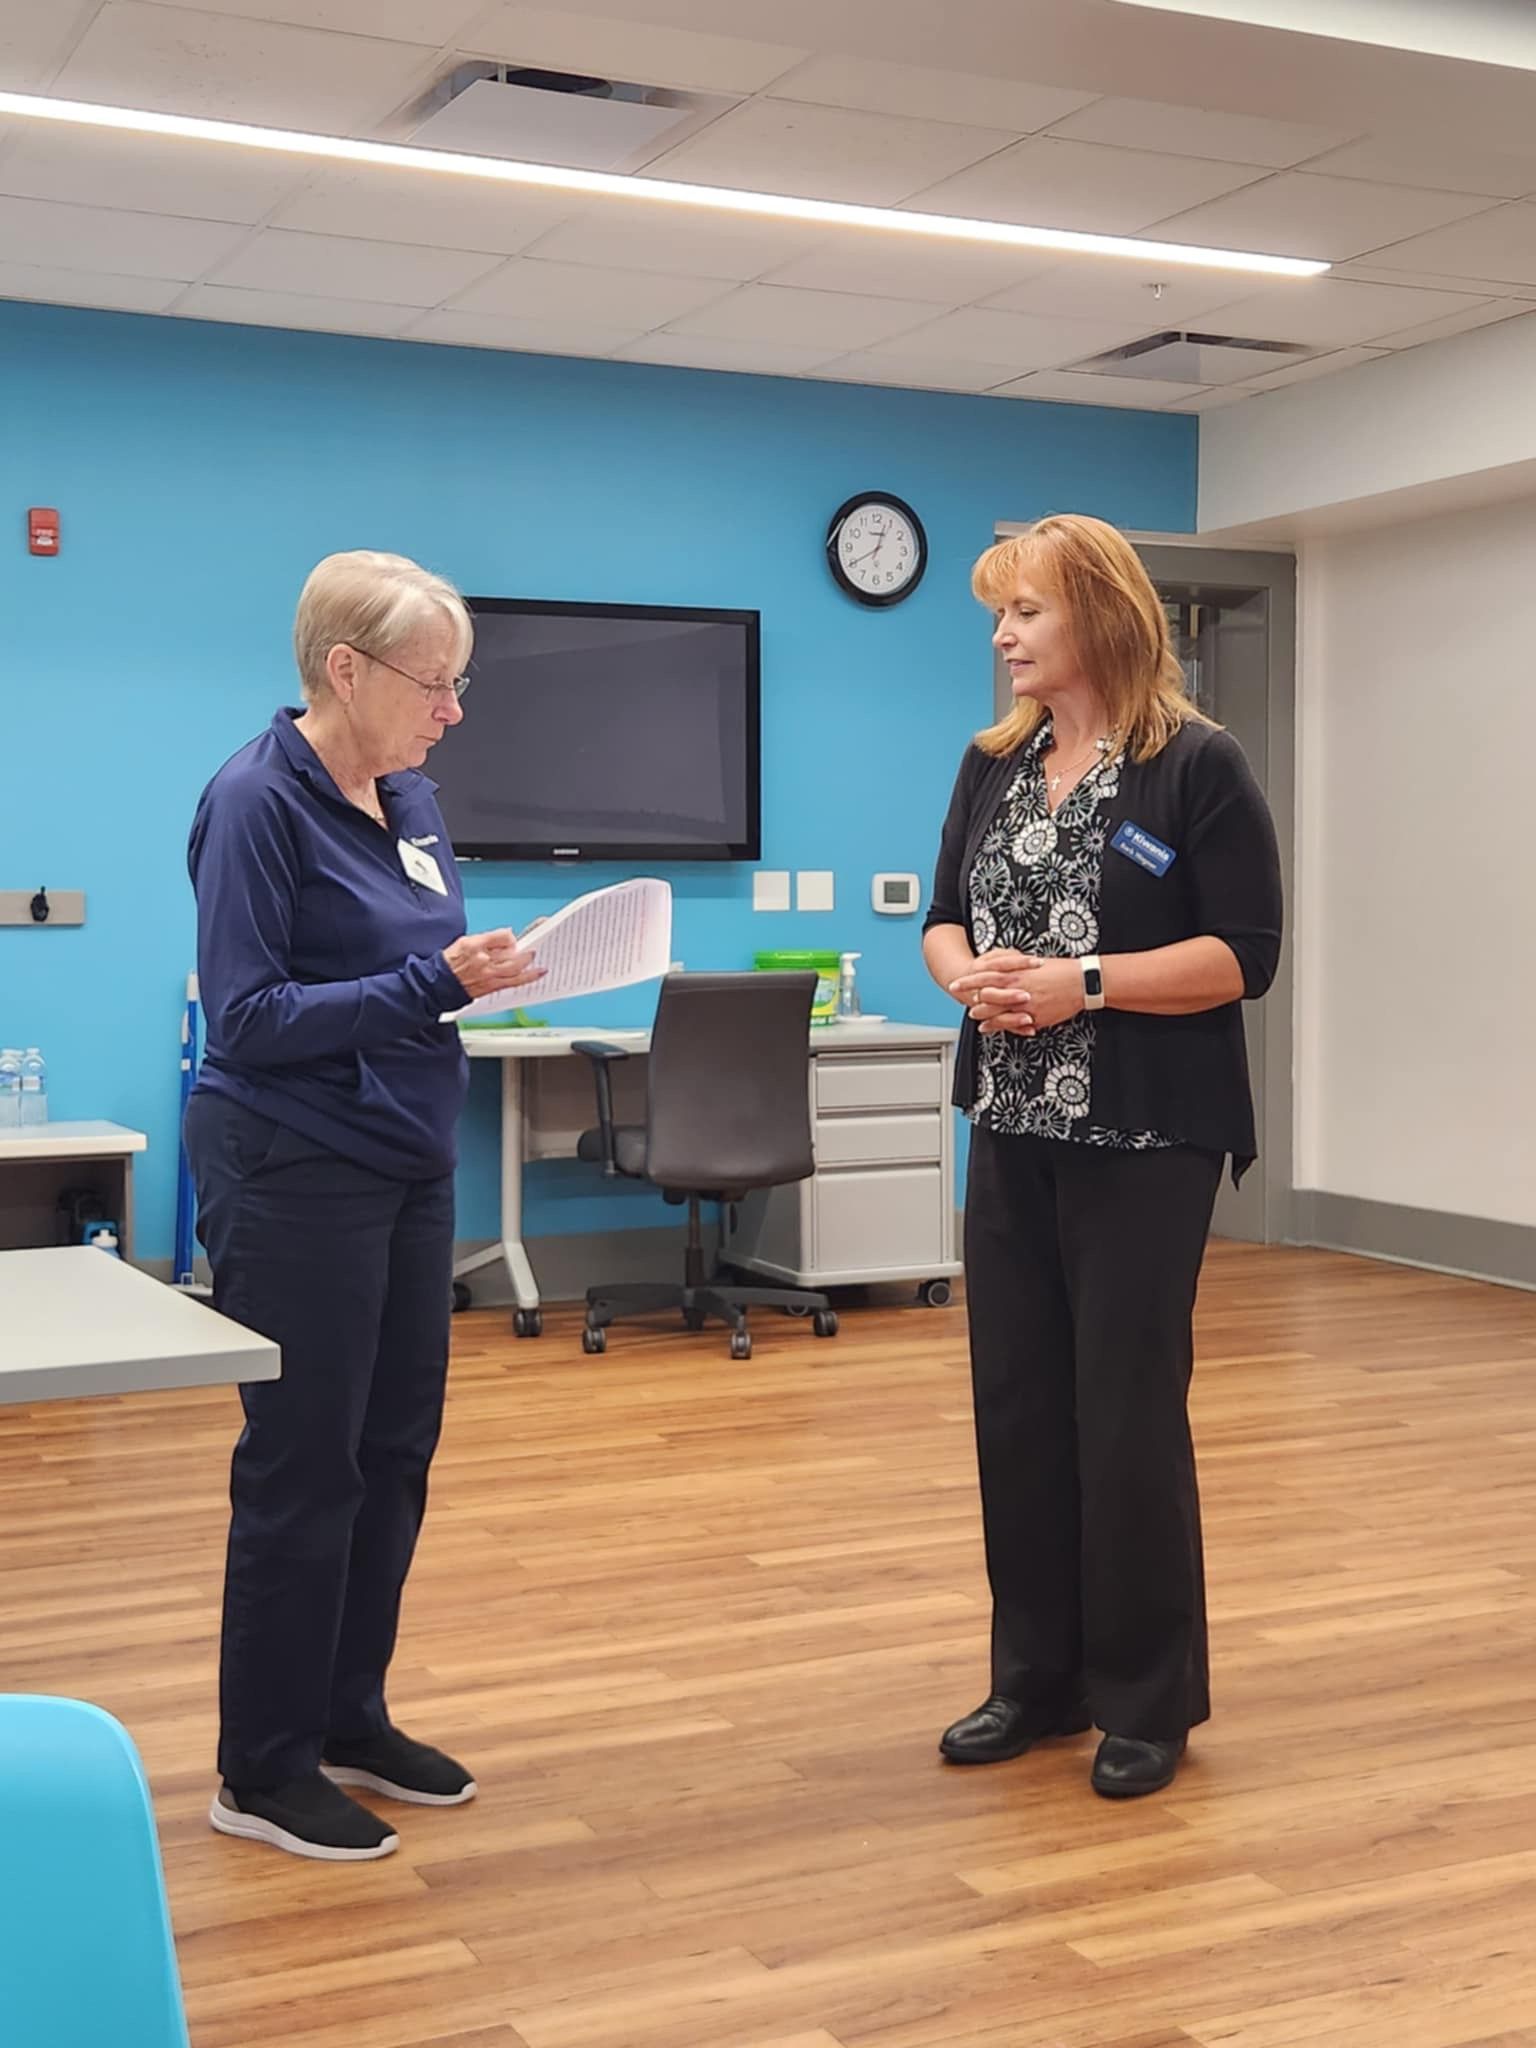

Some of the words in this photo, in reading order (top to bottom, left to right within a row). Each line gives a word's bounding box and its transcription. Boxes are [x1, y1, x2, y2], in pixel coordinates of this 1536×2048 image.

[860, 517, 867, 527] 11
[872, 513, 882, 523] 12
[888, 520, 893, 528] 1
[849, 528, 861, 539] 10
[896, 531, 904, 541] 2
[845, 542, 853, 553] 9
[900, 546, 908, 557] 3
[896, 562, 903, 571] 4
[860, 570, 866, 580] 7
[872, 575, 880, 585] 6
[886, 572, 894, 582] 5
[1132, 832, 1169, 861] Kiwanis
